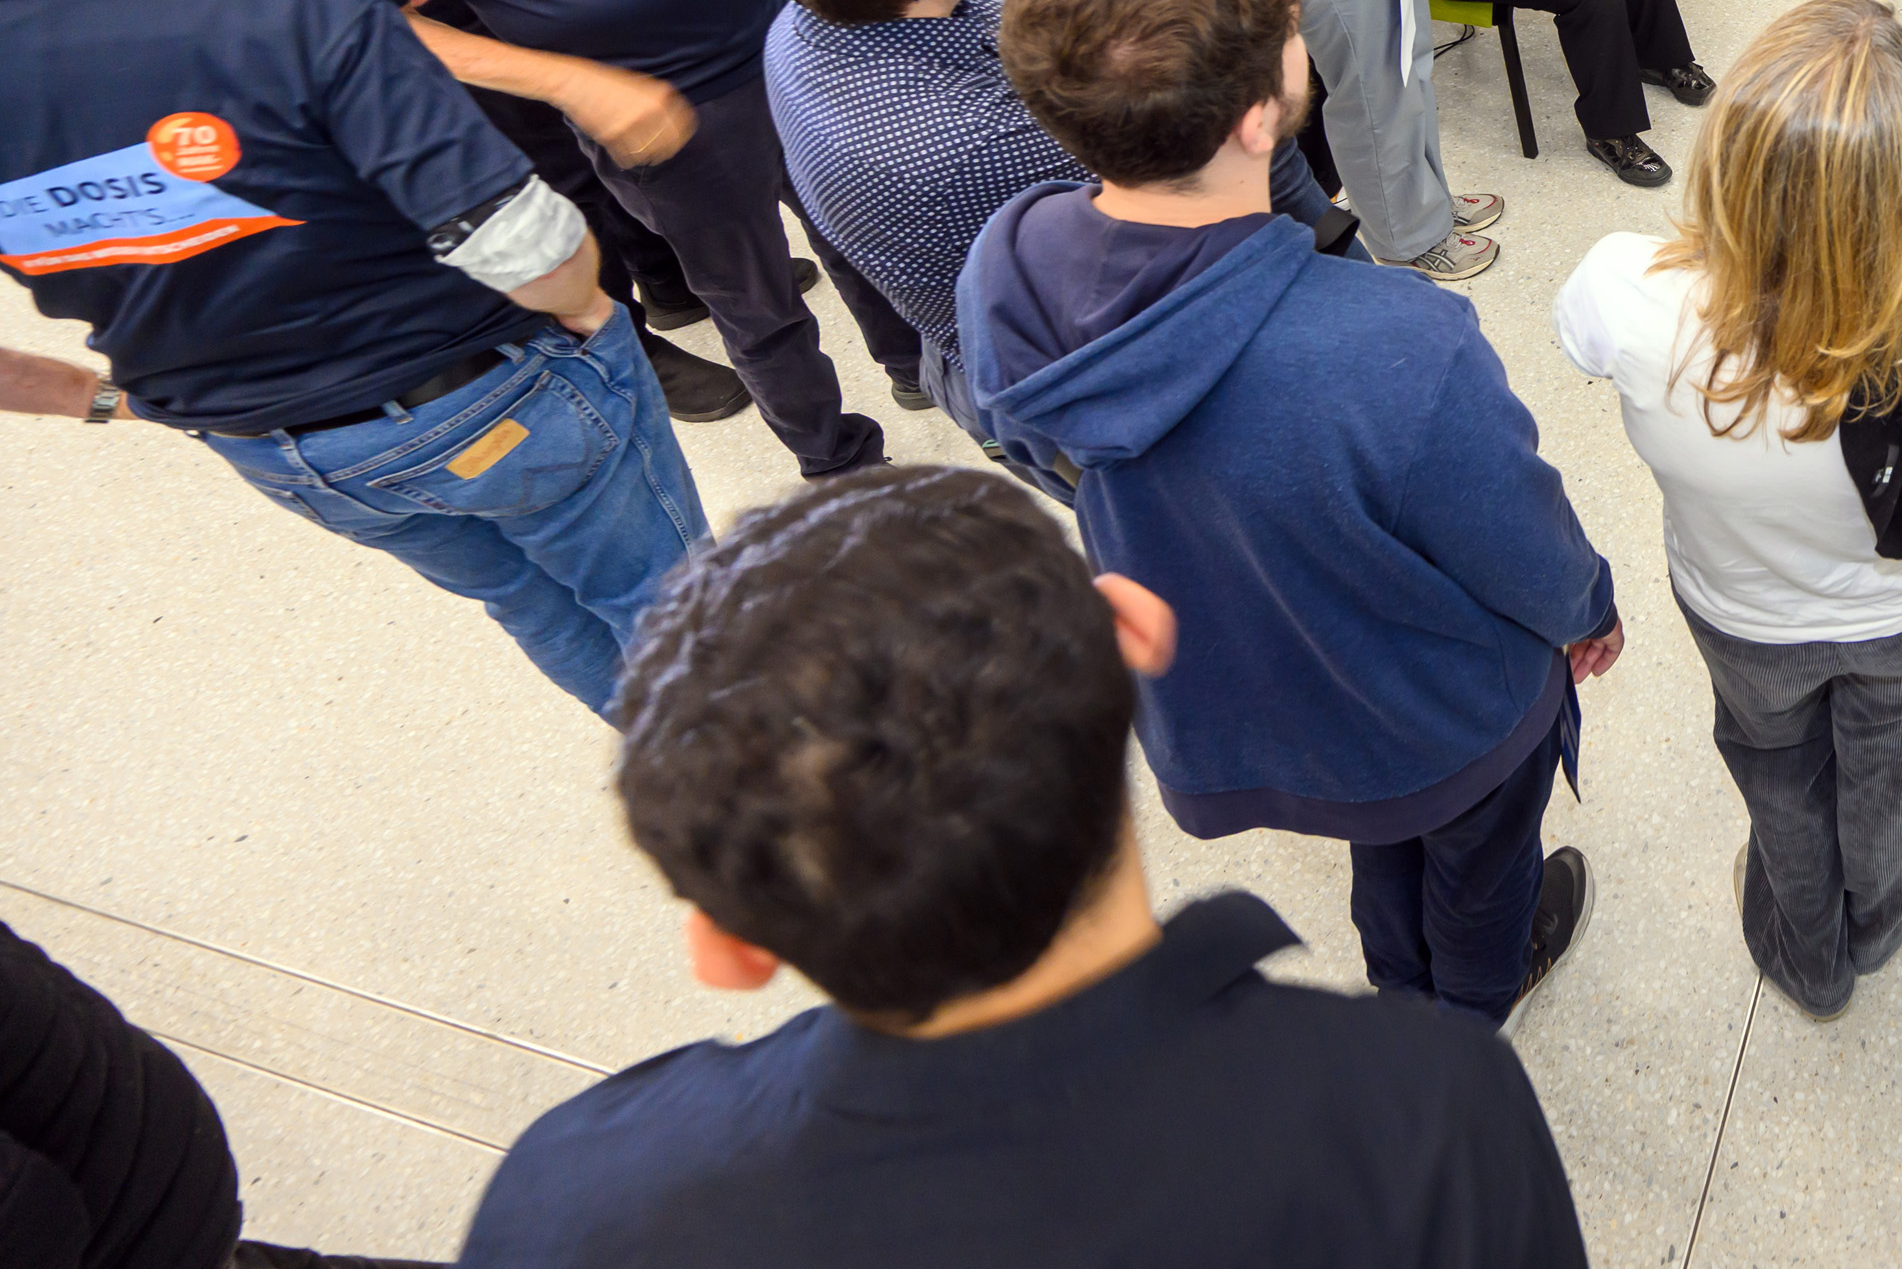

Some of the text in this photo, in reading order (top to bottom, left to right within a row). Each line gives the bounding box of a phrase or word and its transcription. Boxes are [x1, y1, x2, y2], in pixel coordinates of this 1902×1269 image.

[174, 125, 218, 146] 70
[2, 172, 167, 219] DIE DOSIS
